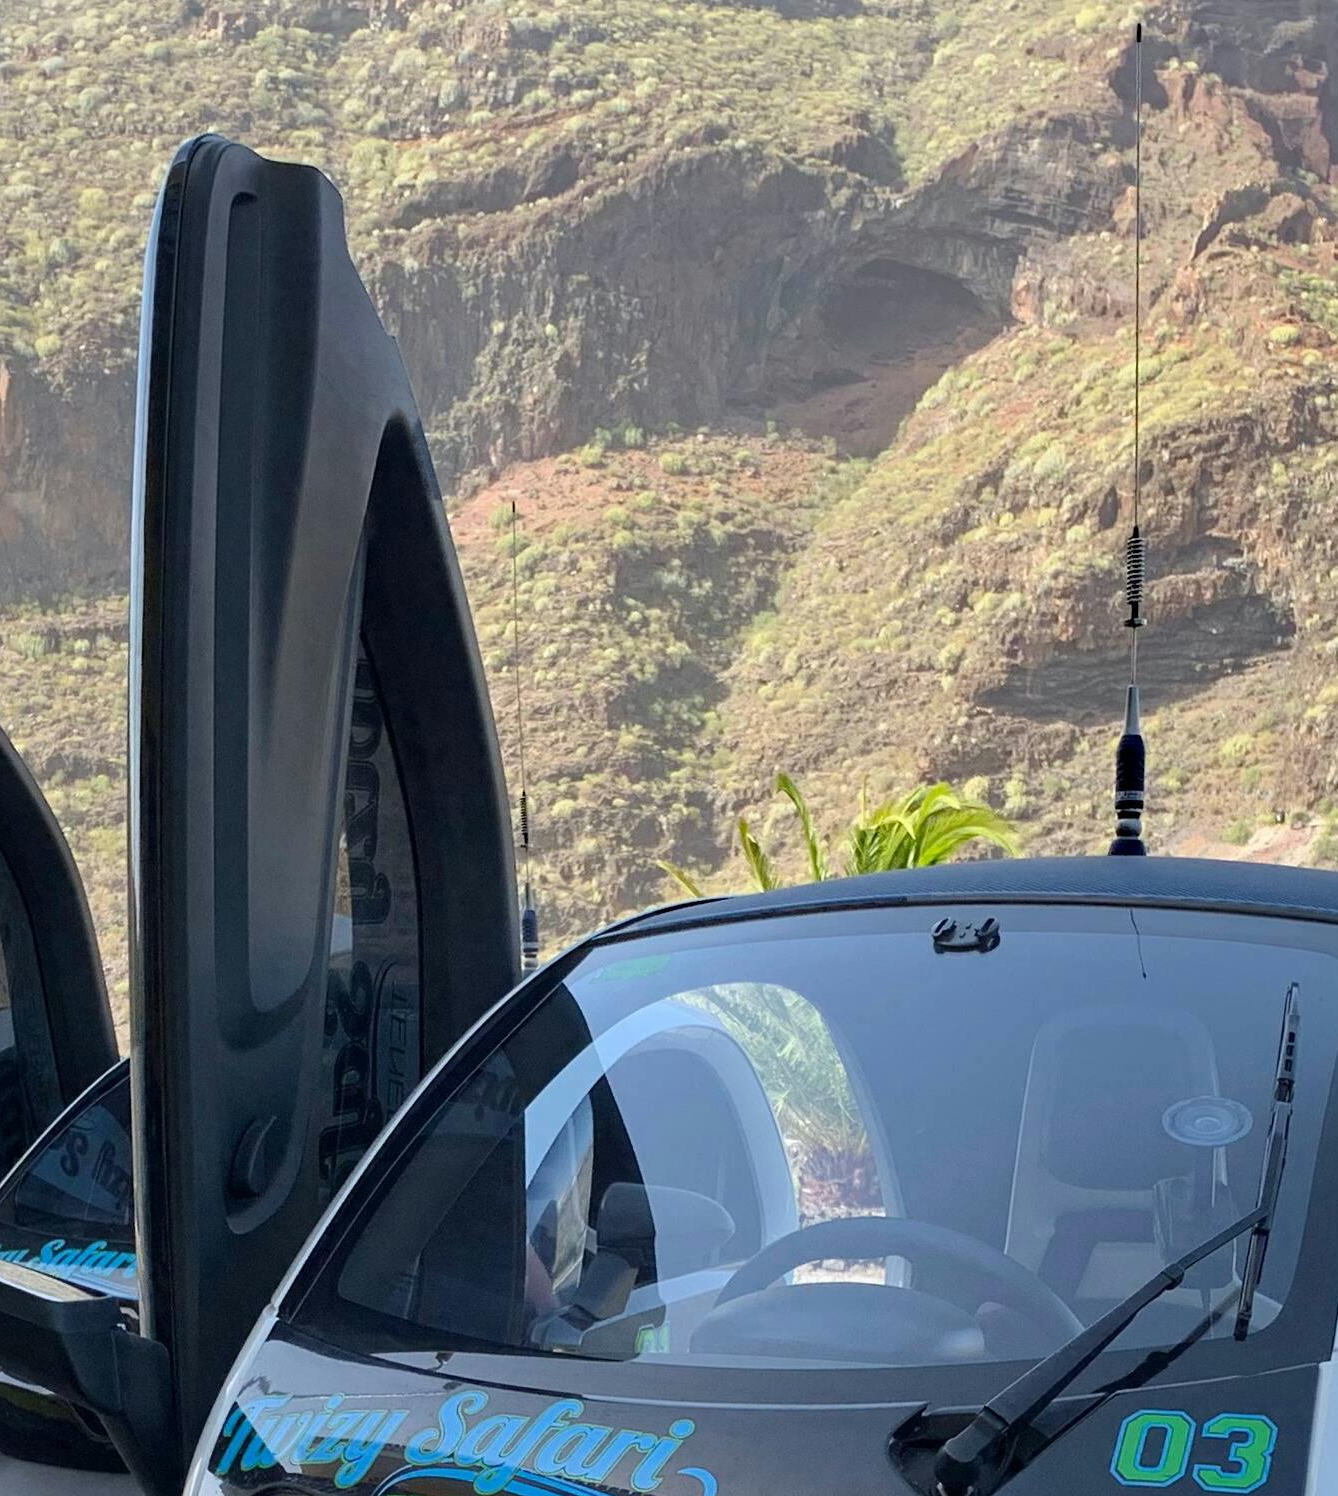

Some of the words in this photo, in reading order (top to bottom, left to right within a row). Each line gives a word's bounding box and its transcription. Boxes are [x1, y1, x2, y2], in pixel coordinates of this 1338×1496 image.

[29, 1239, 137, 1278] Safar
[215, 1391, 410, 1489] Twizy
[404, 1389, 695, 1495] Safari
[1109, 1409, 1279, 1495] 03
